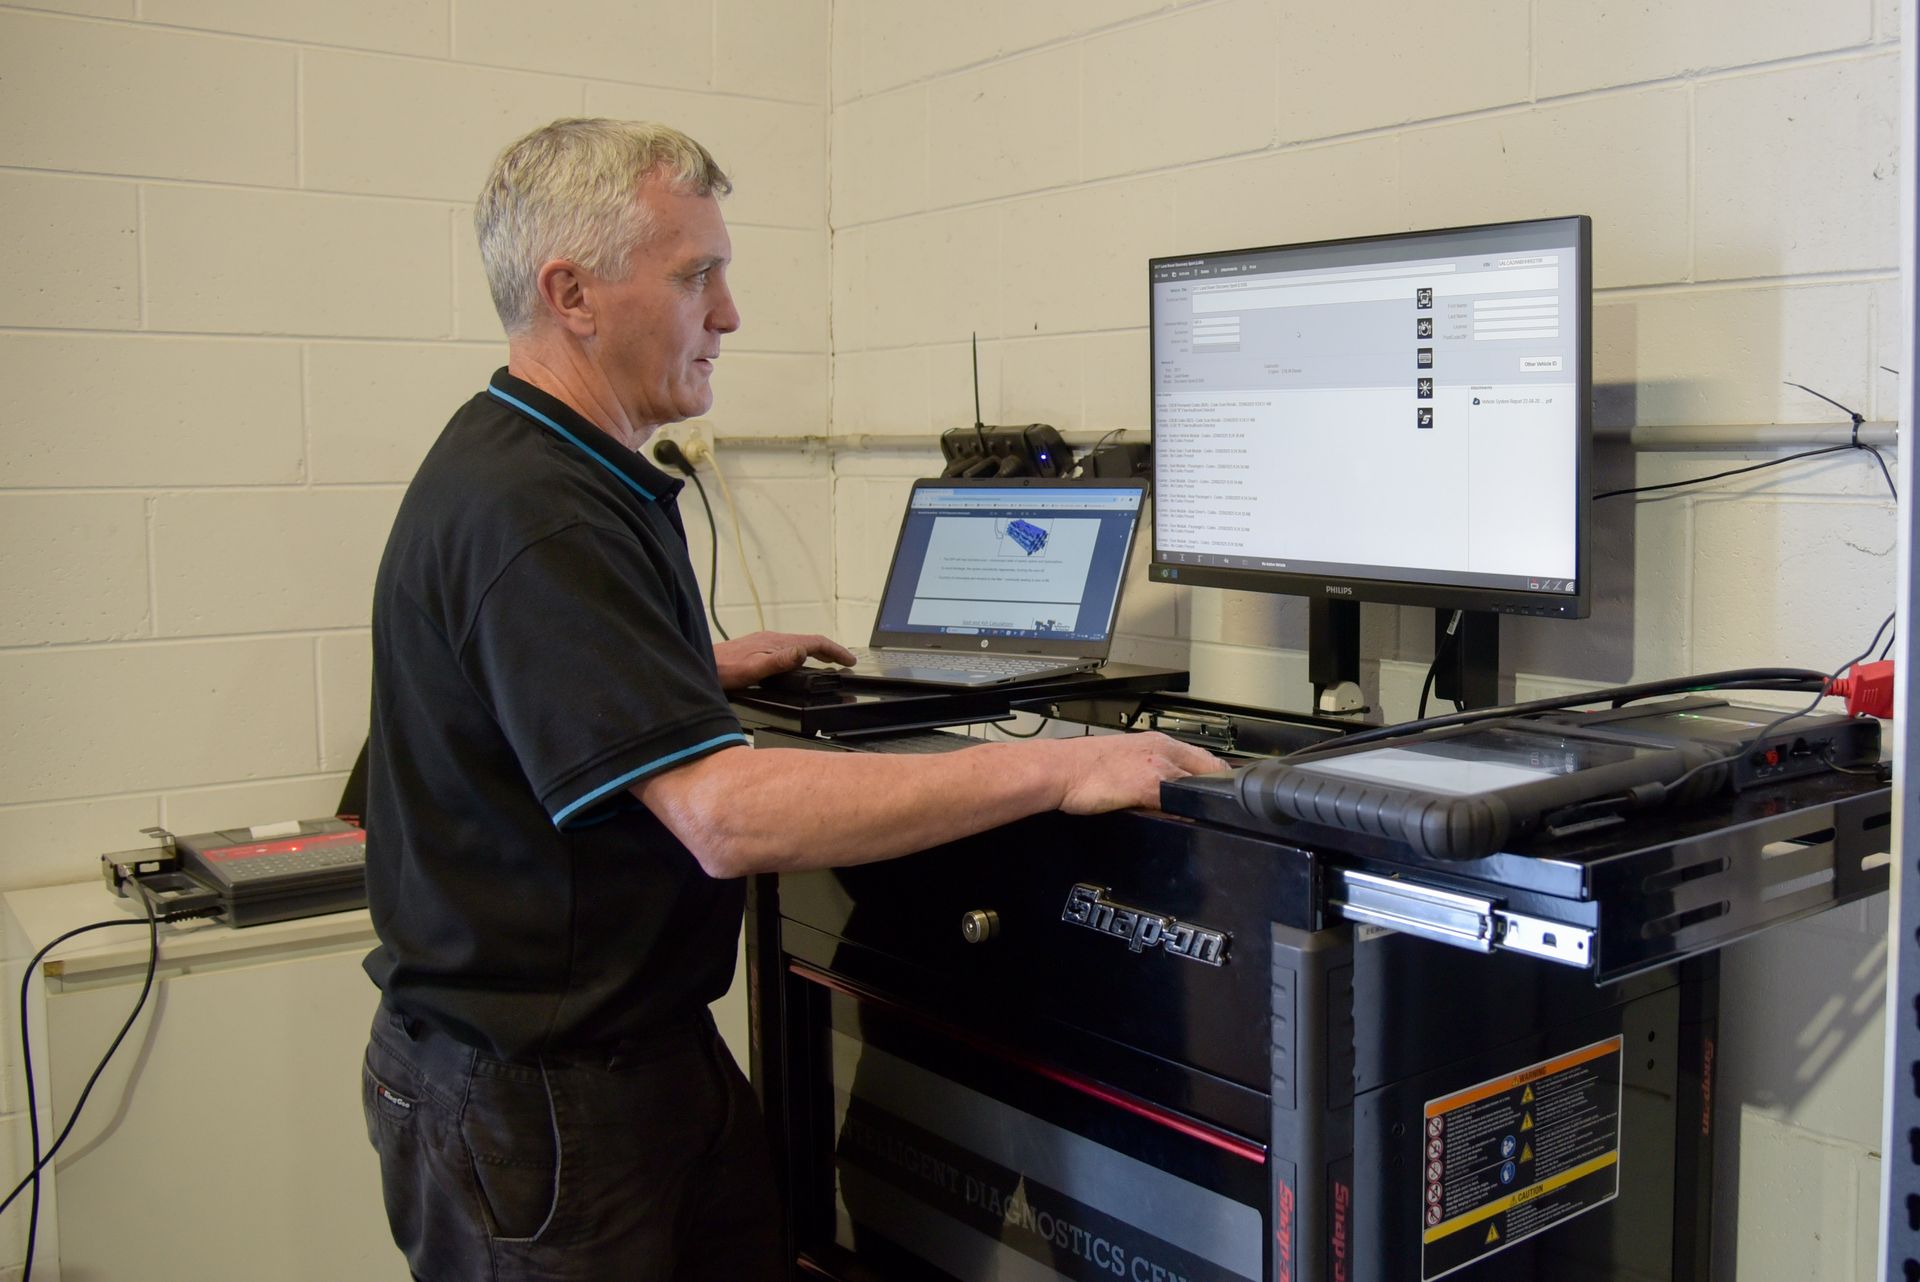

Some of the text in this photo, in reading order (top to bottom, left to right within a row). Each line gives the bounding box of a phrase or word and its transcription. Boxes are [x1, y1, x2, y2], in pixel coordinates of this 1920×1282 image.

[1326, 585, 1352, 595] PHILIPS
[1062, 884, 1226, 968] Snap-on
[1519, 1067, 1547, 1083] WARNING
[1517, 1184, 1544, 1202] CAUTION
[965, 1175, 1127, 1277] DIAGNOSTICS
